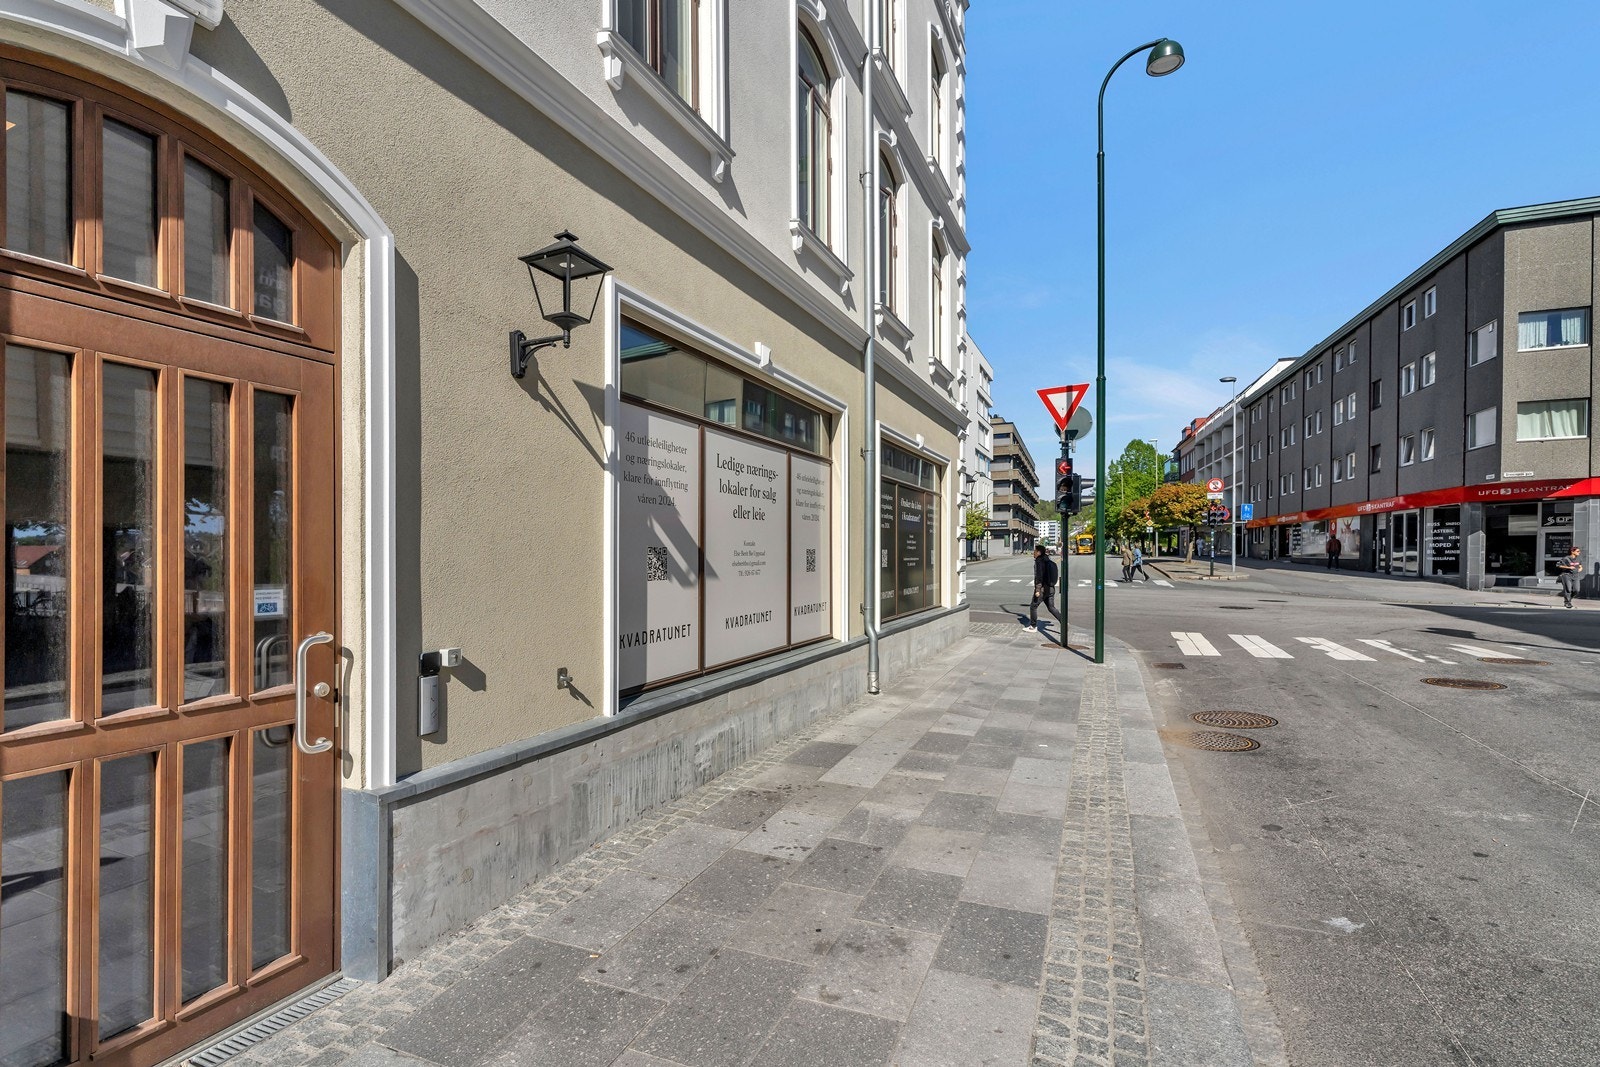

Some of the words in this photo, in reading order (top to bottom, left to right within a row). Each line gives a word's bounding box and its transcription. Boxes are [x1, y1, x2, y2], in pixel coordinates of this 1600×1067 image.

[625, 431, 636, 443] 46
[637, 436, 688, 455] utleieleiligheter
[625, 454, 635, 466] og
[716, 453, 744, 476] Ledige
[746, 464, 779, 482] nærings-
[624, 470, 642, 484] klare
[644, 474, 654, 486] for
[655, 476, 688, 492] innflytting
[720, 478, 748, 497] lokaler
[750, 484, 761, 499] for
[762, 487, 776, 504] salg
[1513, 484, 1574, 494] SKANTRAF
[638, 493, 656, 504] våren
[658, 494, 677, 507] 2024.
[732, 504, 750, 520] eller
[752, 506, 766, 521] leie
[794, 602, 827, 616] KVADRATUNET
[725, 610, 772, 630] KVADRATUNET
[619, 624, 691, 650] KVADRATUNET
